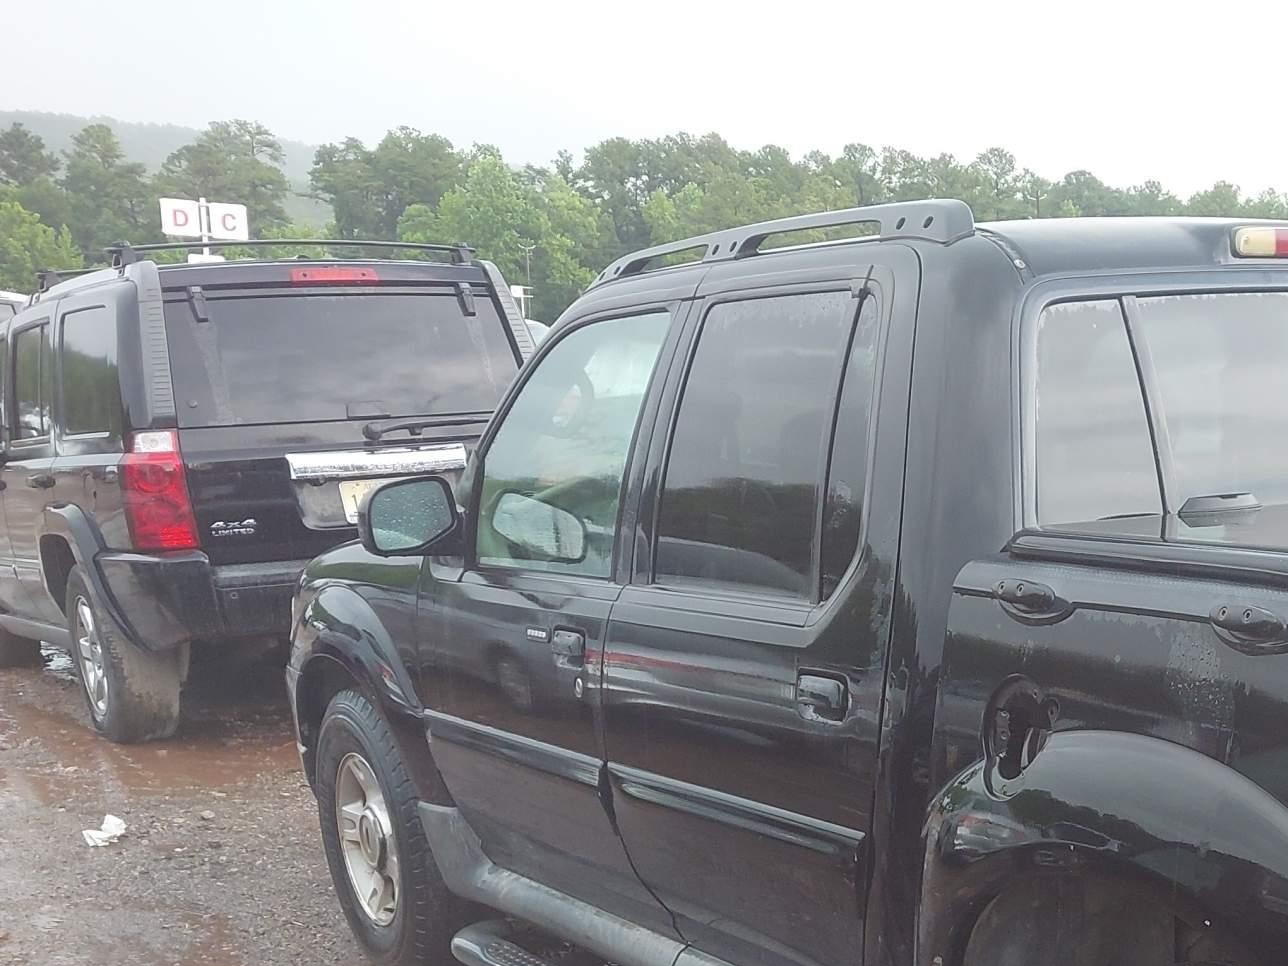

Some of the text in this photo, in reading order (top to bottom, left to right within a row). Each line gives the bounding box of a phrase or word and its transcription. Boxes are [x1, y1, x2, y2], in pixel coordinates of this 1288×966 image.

[173, 209, 189, 227] D
[222, 214, 237, 232] C
[211, 528, 255, 537] LIMITED
